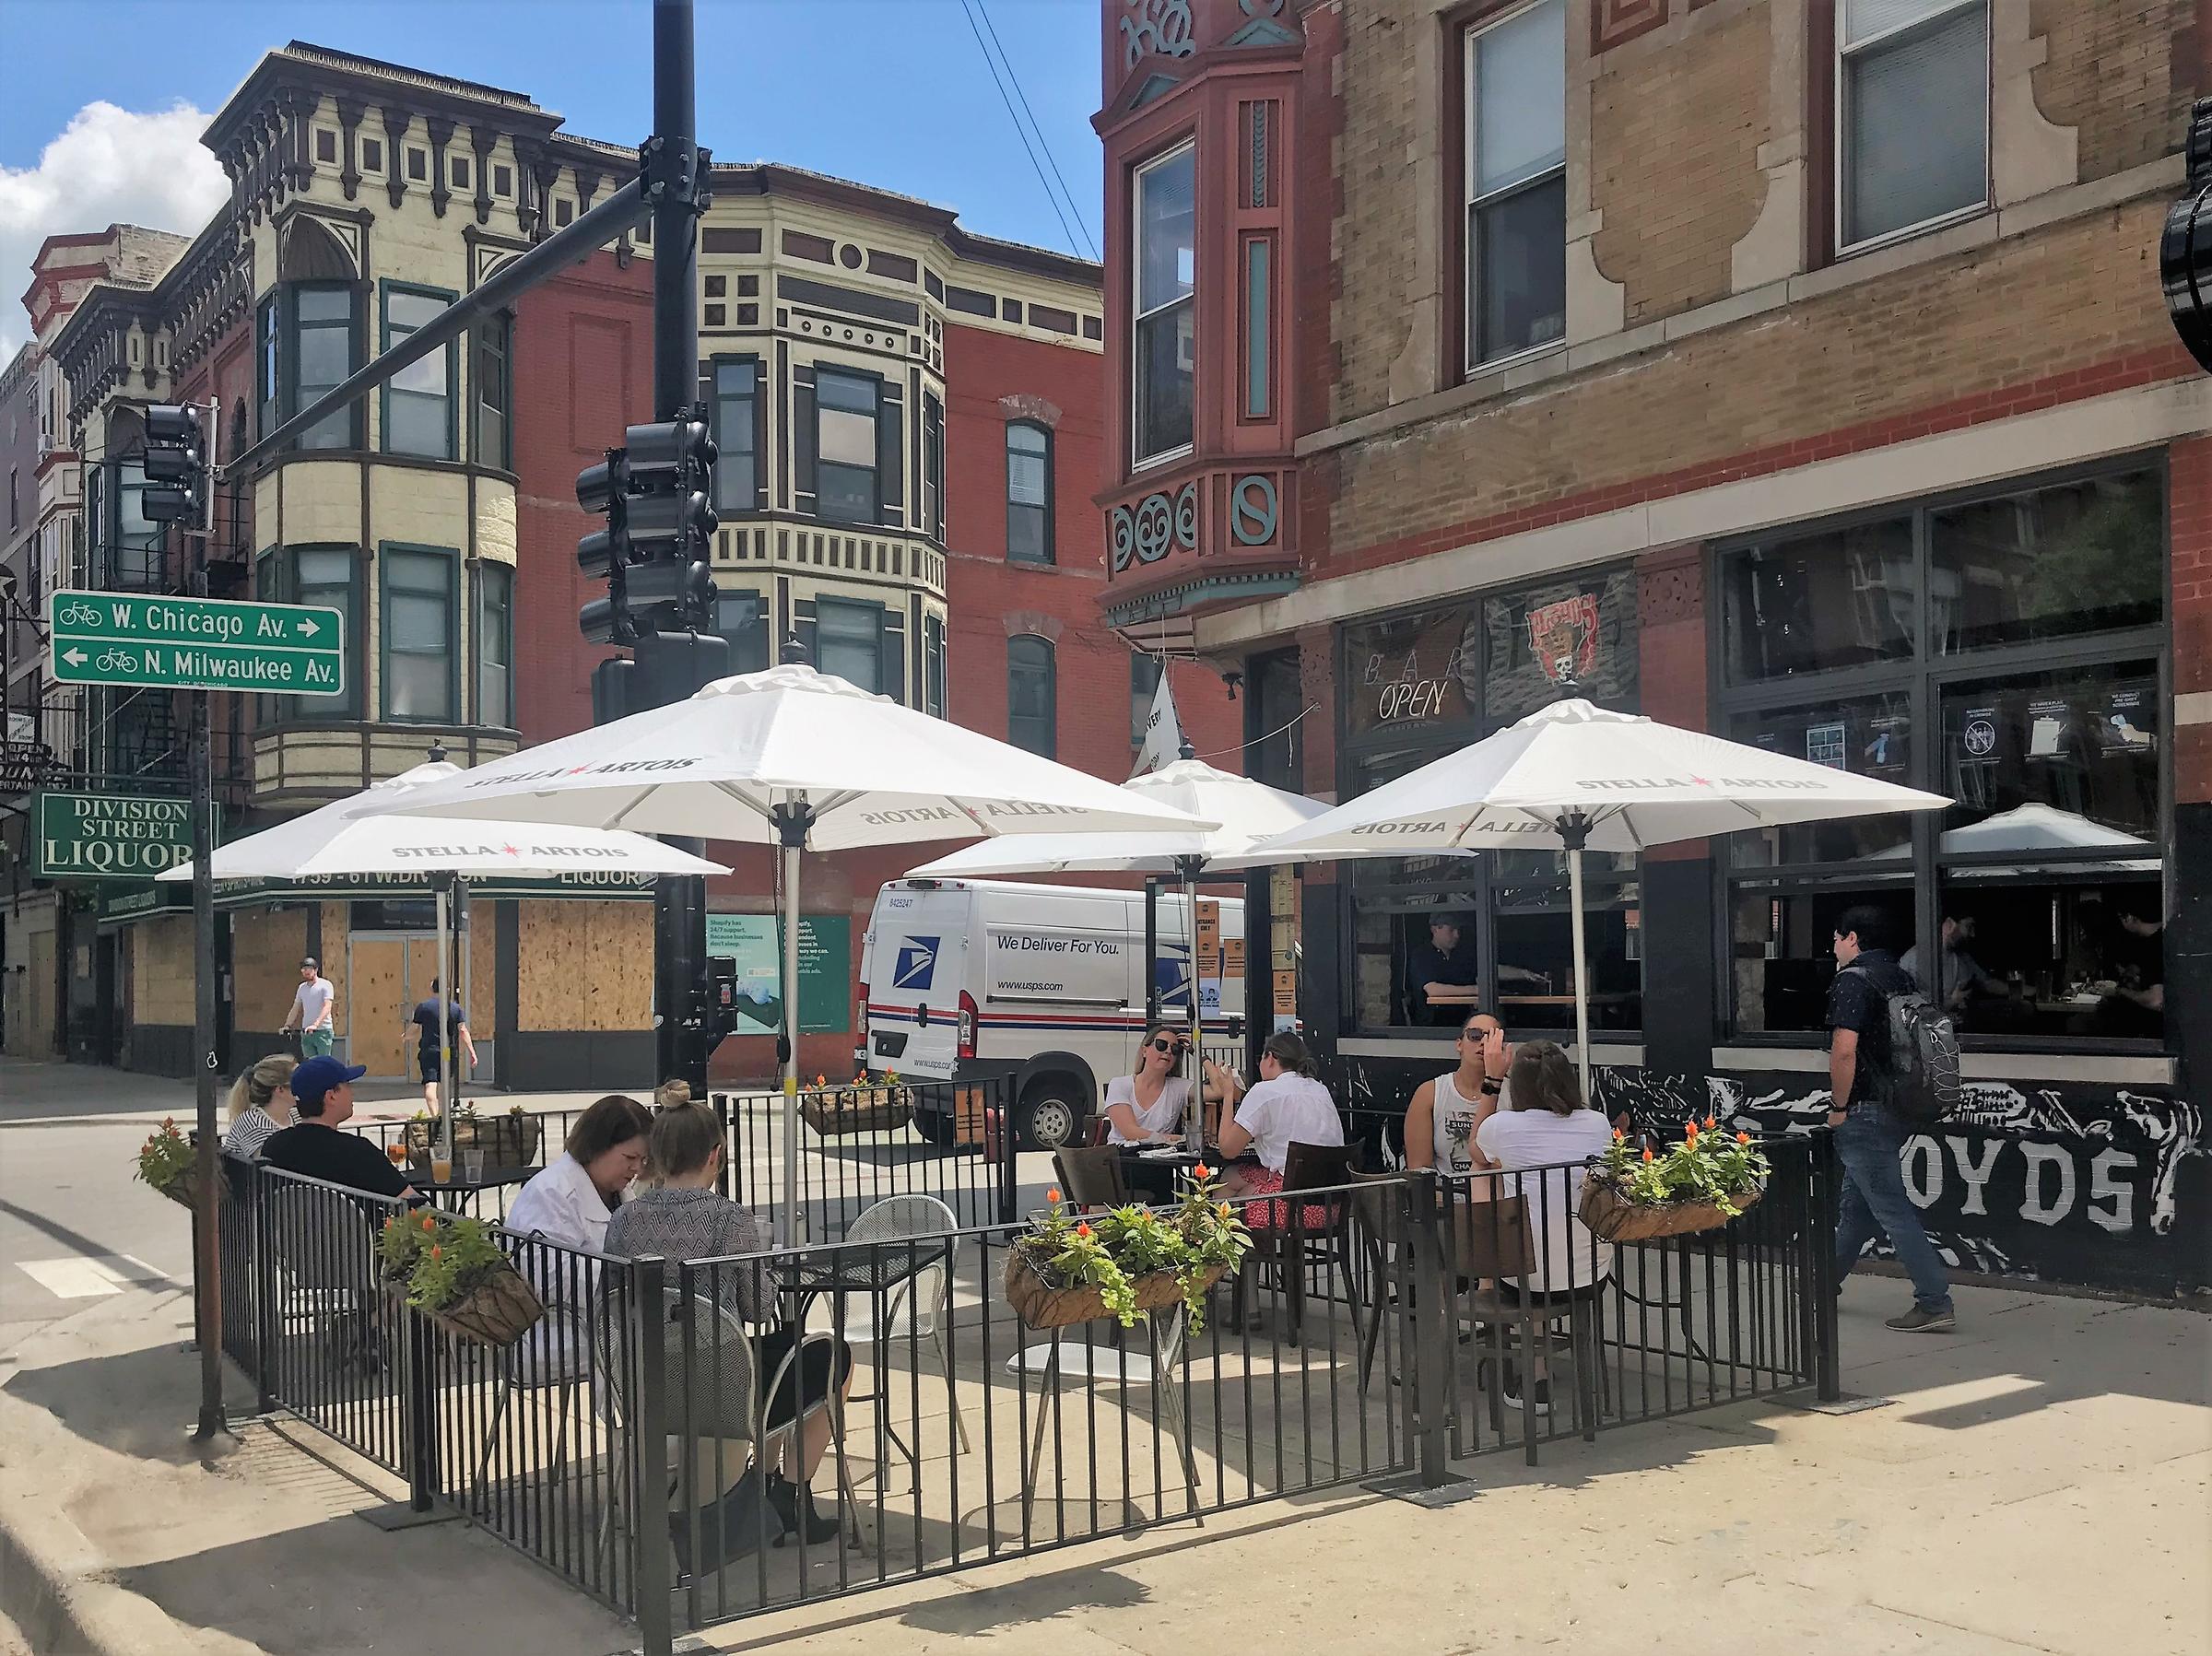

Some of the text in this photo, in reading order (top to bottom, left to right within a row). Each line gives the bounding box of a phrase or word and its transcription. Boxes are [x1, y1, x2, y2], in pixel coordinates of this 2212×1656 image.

[112, 603, 288, 642] W. Chicago Av.
[145, 649, 335, 684] N. Milwaukee Av.
[1379, 680, 1447, 719] OPEN
[8, 744, 44, 755] OPEN
[465, 758, 702, 789] STELLA ARTOIS
[1575, 777, 1829, 790] STELLA ARTOIS
[74, 799, 189, 821] DIVISION
[82, 819, 180, 840] STREET
[392, 846, 629, 857] STELLA ARTOIS
[997, 935, 1119, 955] We Deliver For You.
[997, 981, 1064, 992] www.usps.com
